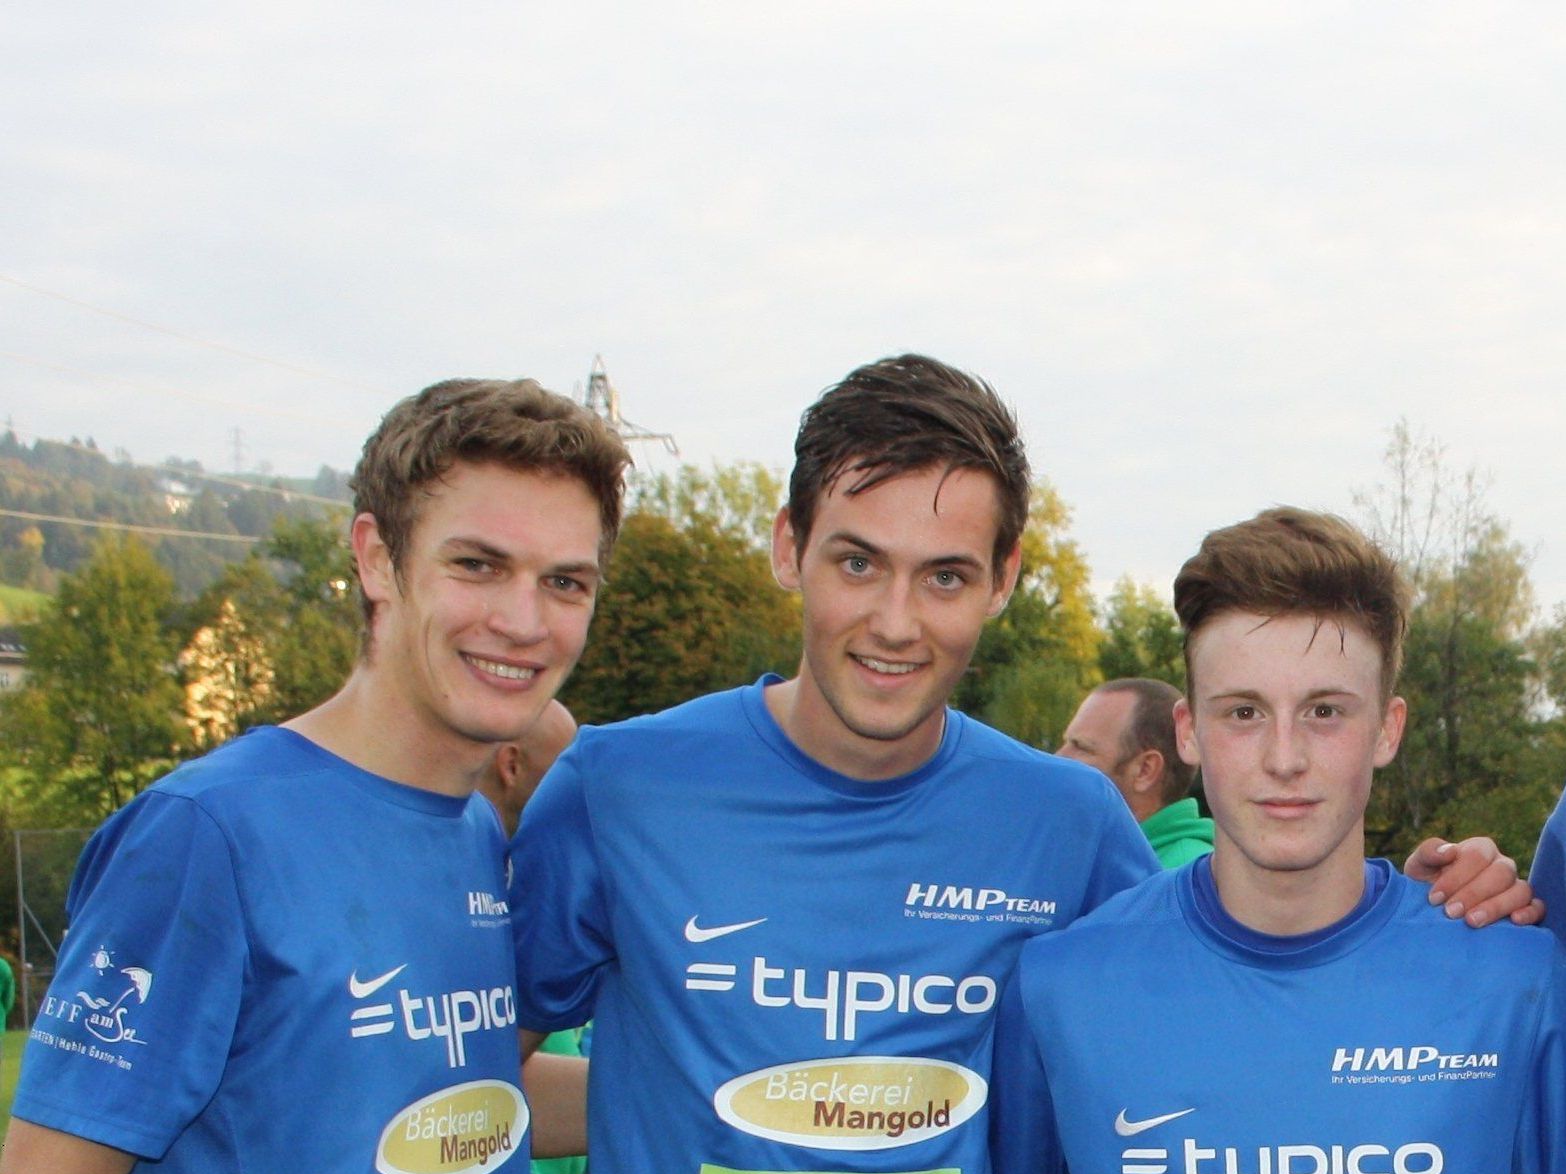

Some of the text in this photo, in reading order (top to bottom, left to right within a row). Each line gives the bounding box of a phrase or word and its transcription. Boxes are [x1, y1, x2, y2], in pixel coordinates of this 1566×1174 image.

[90, 1012, 114, 1028] am
[752, 957, 997, 1041] typico
[400, 984, 517, 1068] typico
[765, 1071, 914, 1105] Bäckerei
[405, 1099, 489, 1142] Bäckerei
[813, 1100, 950, 1137] Mangold
[440, 1121, 512, 1166] Mangold
